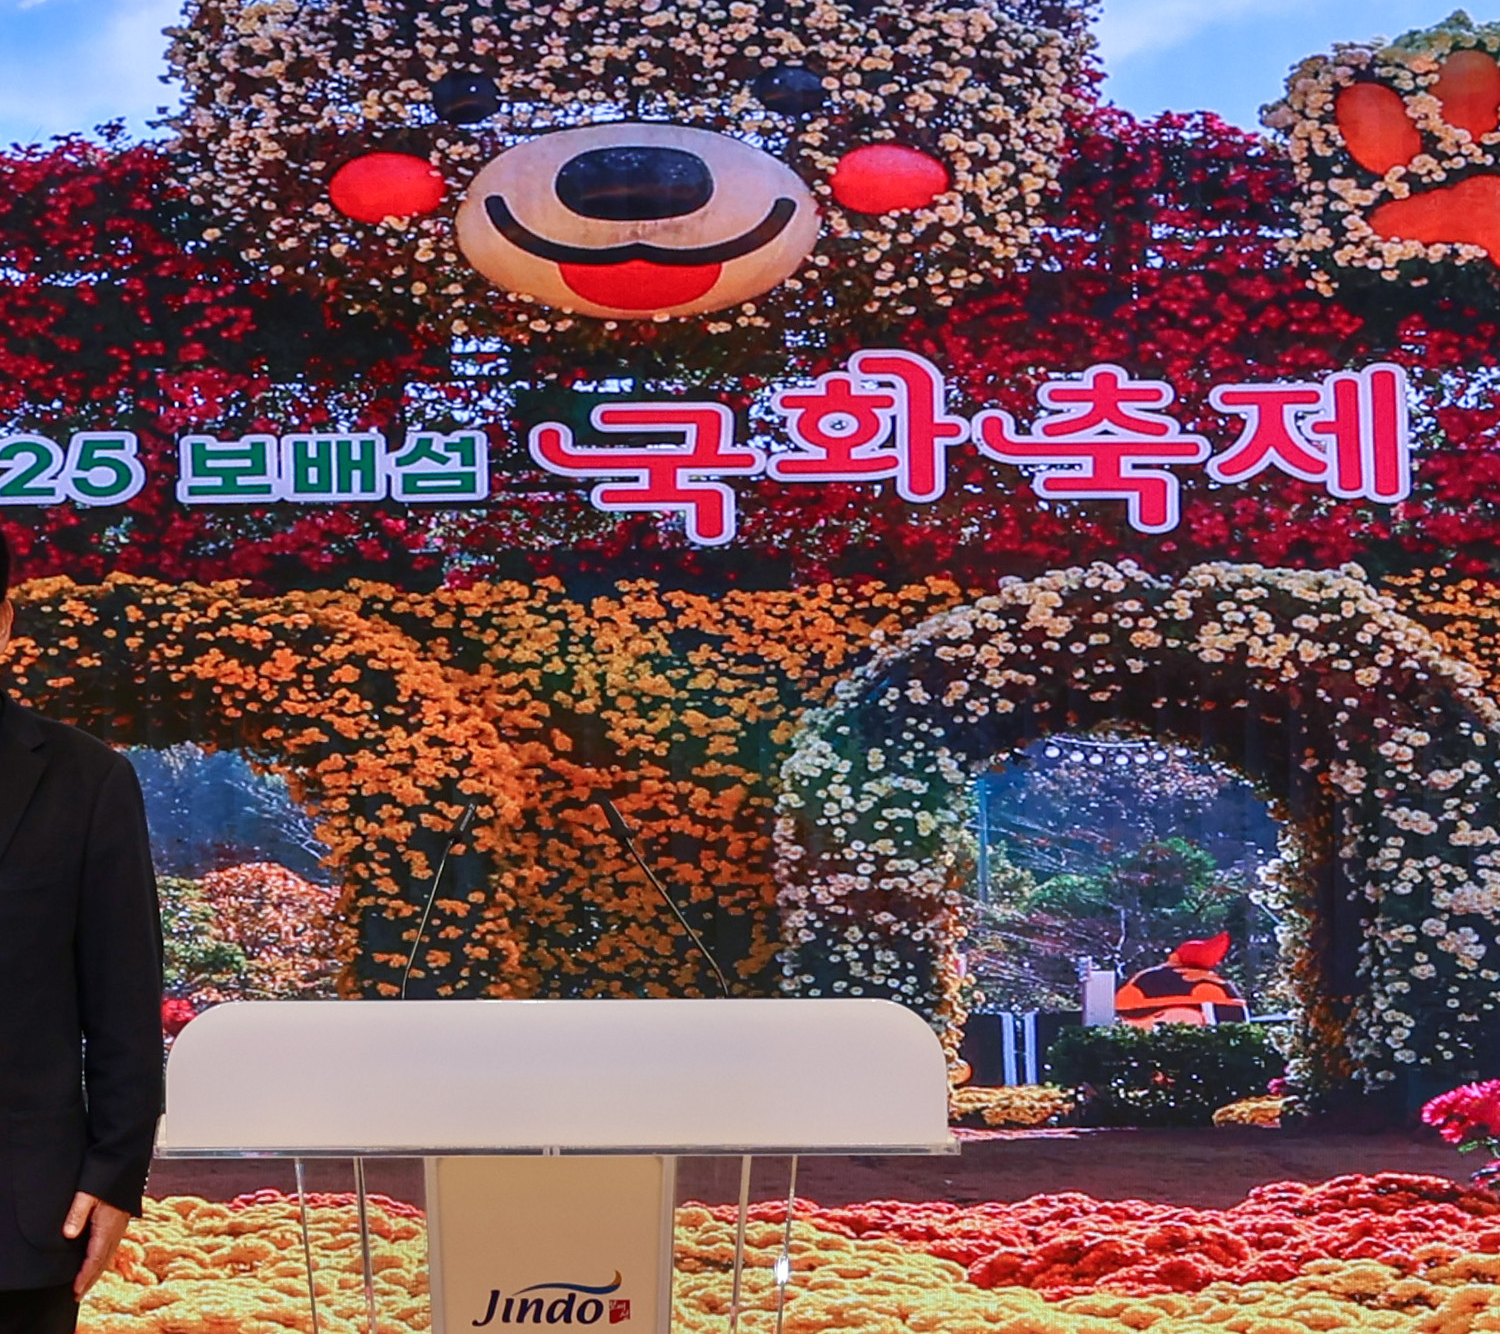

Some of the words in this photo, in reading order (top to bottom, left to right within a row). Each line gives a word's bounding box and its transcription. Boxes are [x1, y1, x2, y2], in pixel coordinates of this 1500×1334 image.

[176, 432, 491, 504] 보배섬
[528, 349, 1413, 547] 국화축제
[471, 1289, 604, 1327] Jindo
